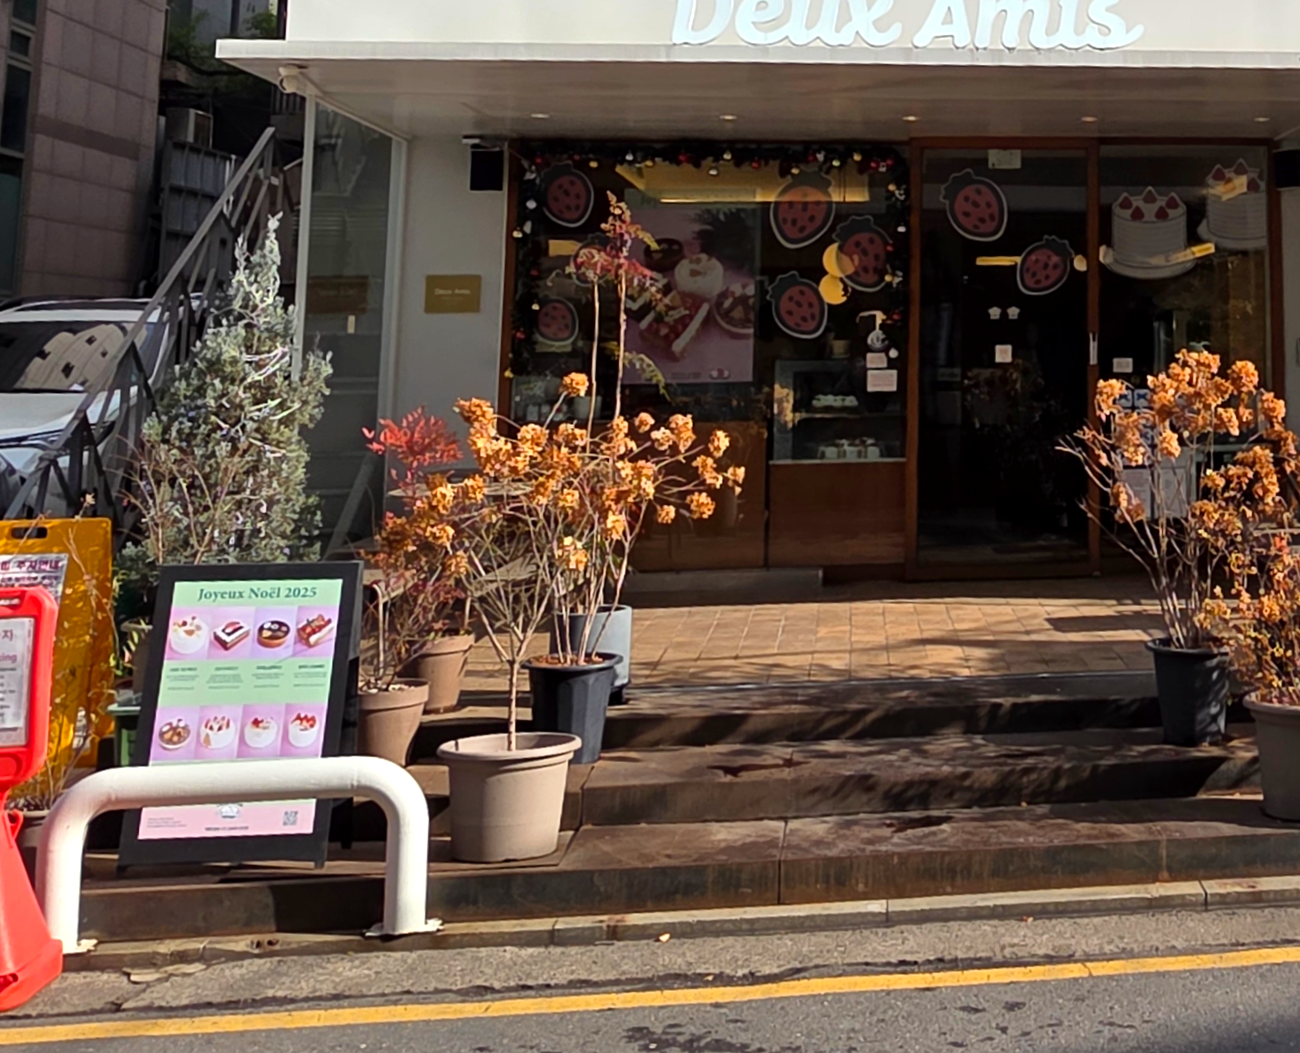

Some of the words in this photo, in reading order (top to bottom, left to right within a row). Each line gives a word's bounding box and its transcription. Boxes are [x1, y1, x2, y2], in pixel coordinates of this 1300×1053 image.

[197, 587, 246, 603] Joyeux
[247, 586, 282, 599] Noël
[284, 586, 318, 599] 2025
